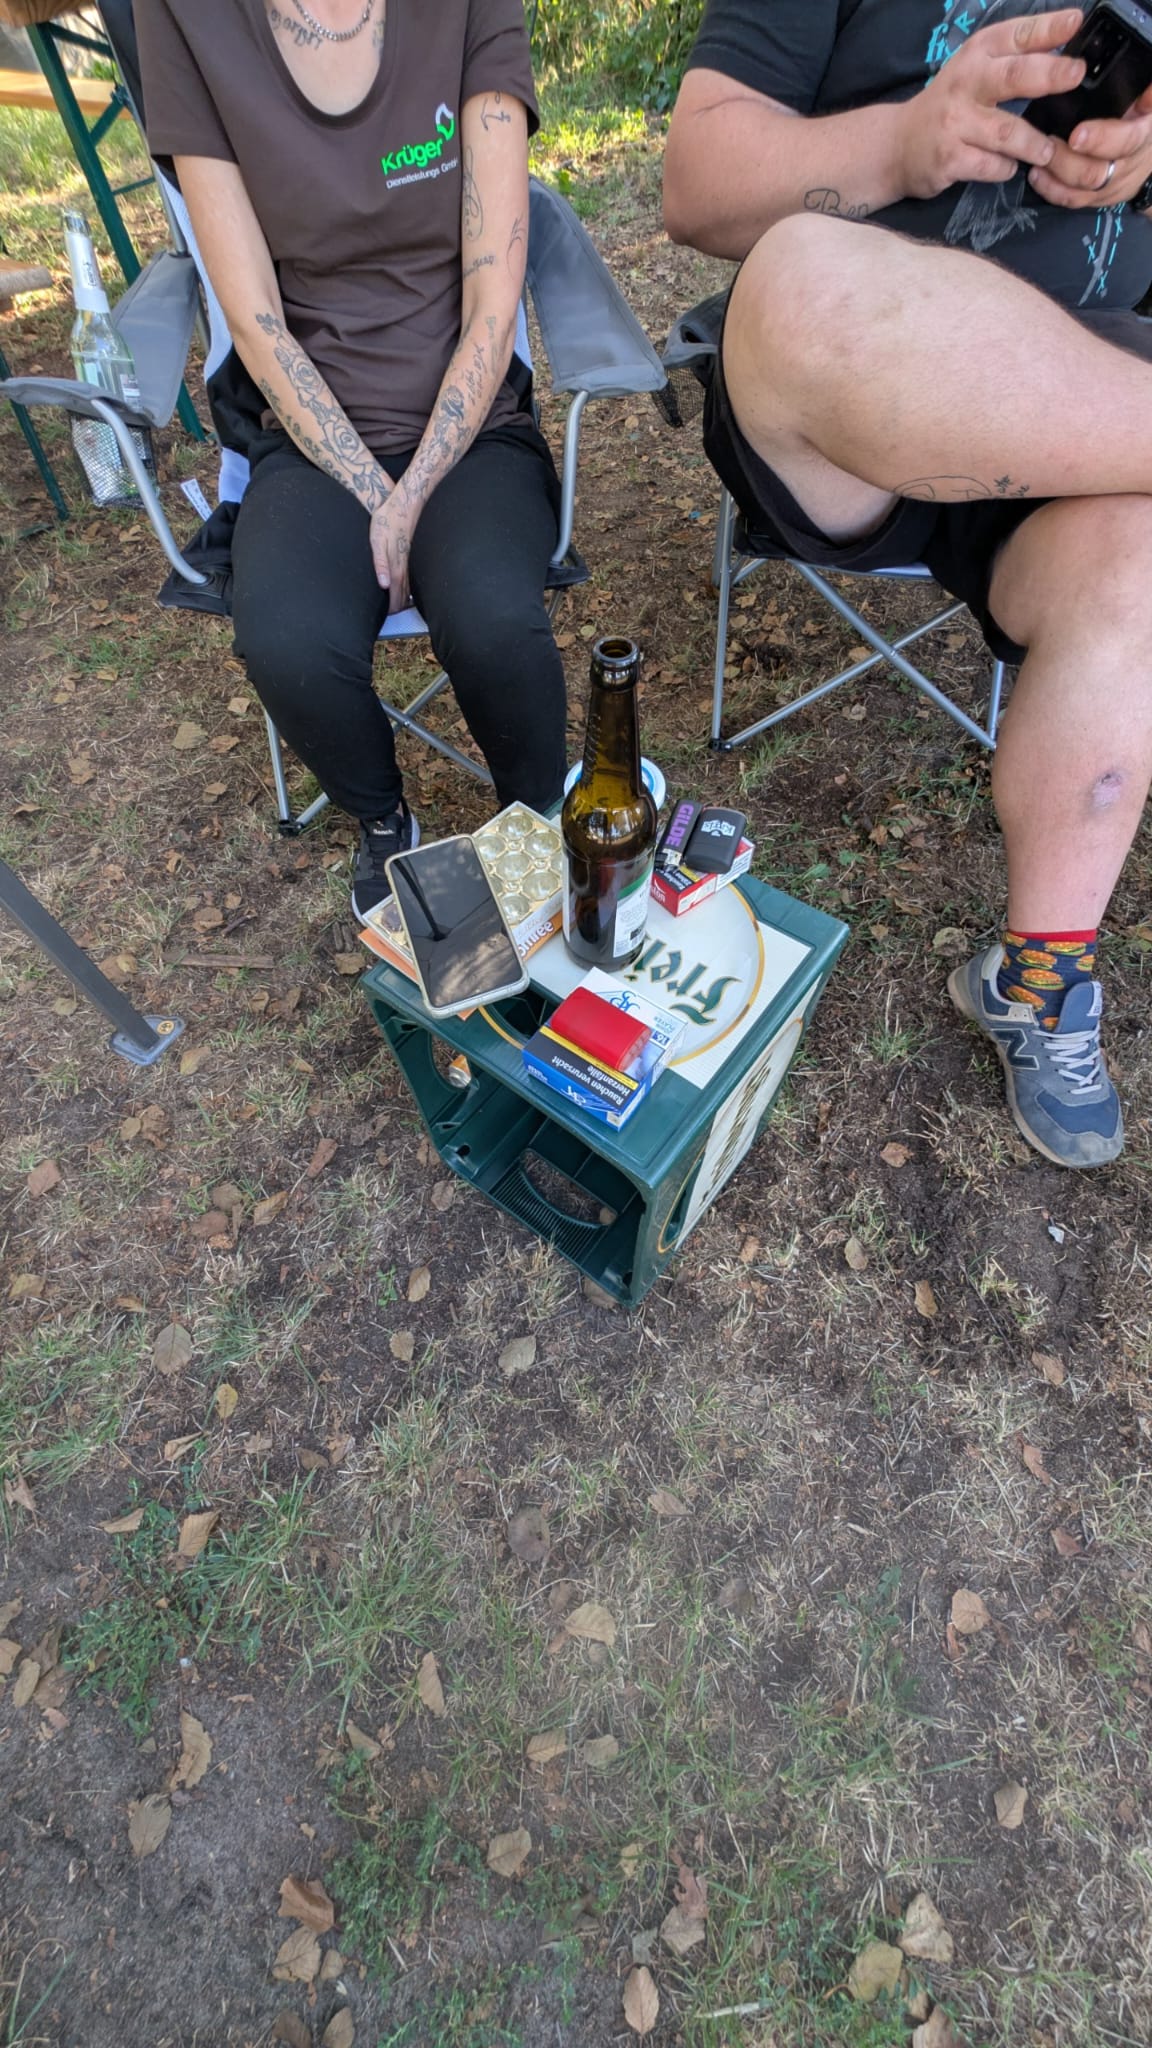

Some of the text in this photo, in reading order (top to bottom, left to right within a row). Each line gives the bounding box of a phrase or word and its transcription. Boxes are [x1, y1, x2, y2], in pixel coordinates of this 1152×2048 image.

[381, 138, 443, 176] Krüger
[385, 167, 441, 190] Dienstleistungs
[624, 936, 743, 1026] Frei
[551, 1055, 590, 1085] verursacht
[587, 1065, 631, 1097] Herzanfälle
[589, 1078, 625, 1106] Rauchen
